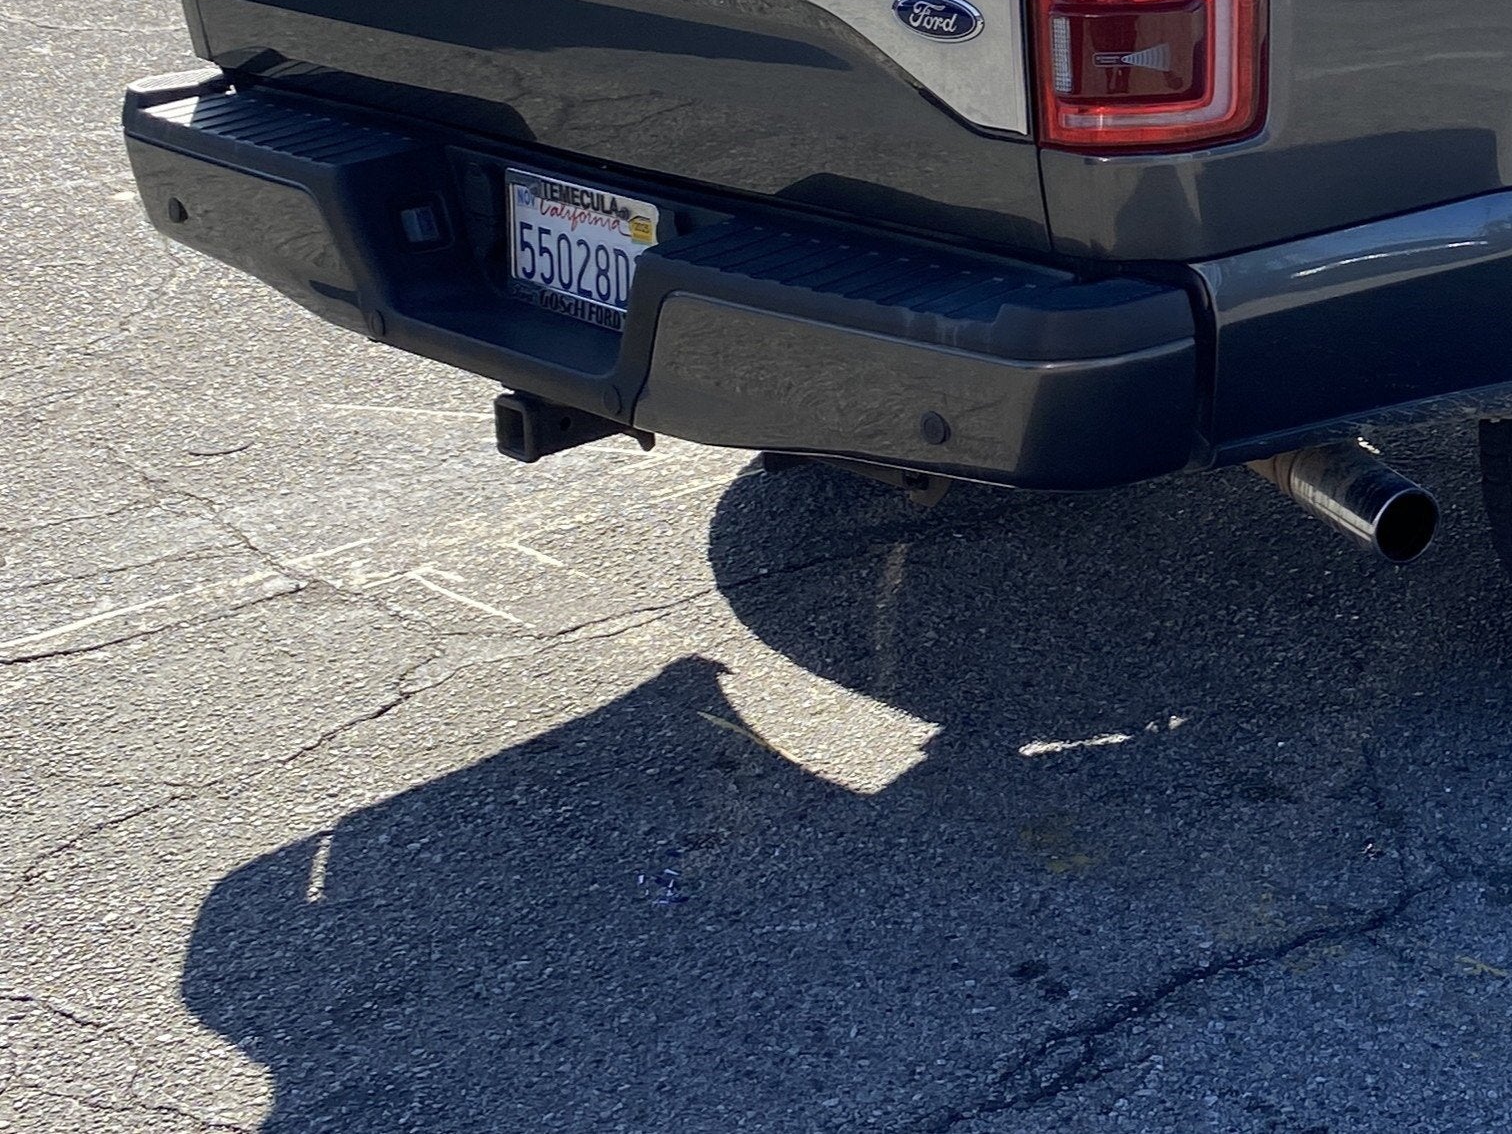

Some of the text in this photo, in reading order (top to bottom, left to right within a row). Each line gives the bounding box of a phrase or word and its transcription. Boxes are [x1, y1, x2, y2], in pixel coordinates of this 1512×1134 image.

[908, 0, 958, 33] Ford
[541, 180, 619, 216] TEMECULA
[519, 221, 640, 308] 55028D
